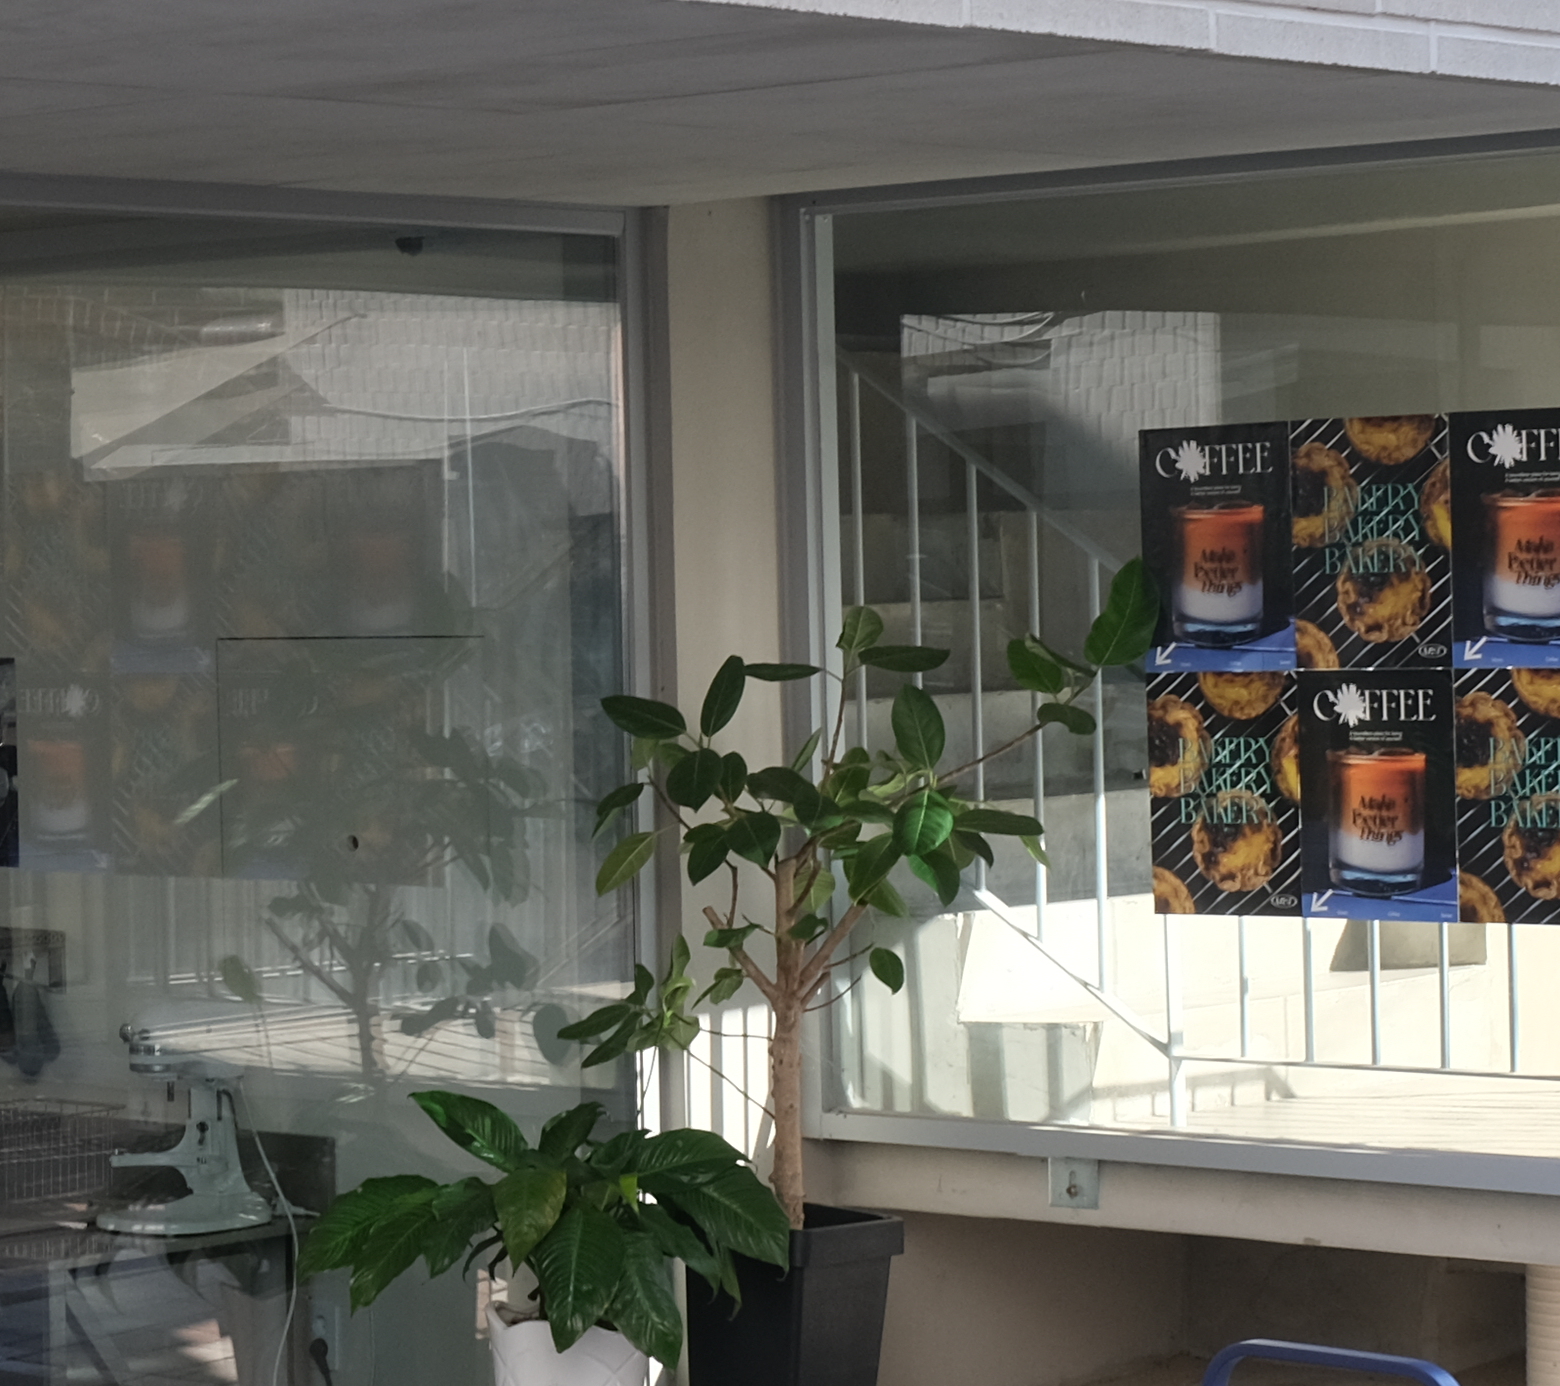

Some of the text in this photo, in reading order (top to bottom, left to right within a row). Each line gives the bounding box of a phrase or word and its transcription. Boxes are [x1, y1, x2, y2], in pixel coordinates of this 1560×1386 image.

[1155, 441, 1274, 479] CFFEE
[1323, 483, 1420, 512] BAKERY
[1324, 513, 1420, 543] BAKERY
[1325, 546, 1422, 574] BAKERY
[1313, 688, 1436, 722] CFFEE
[1179, 737, 1272, 764] BAKERY
[1180, 767, 1272, 794] BAKERY
[1181, 797, 1273, 824] BAKERY
